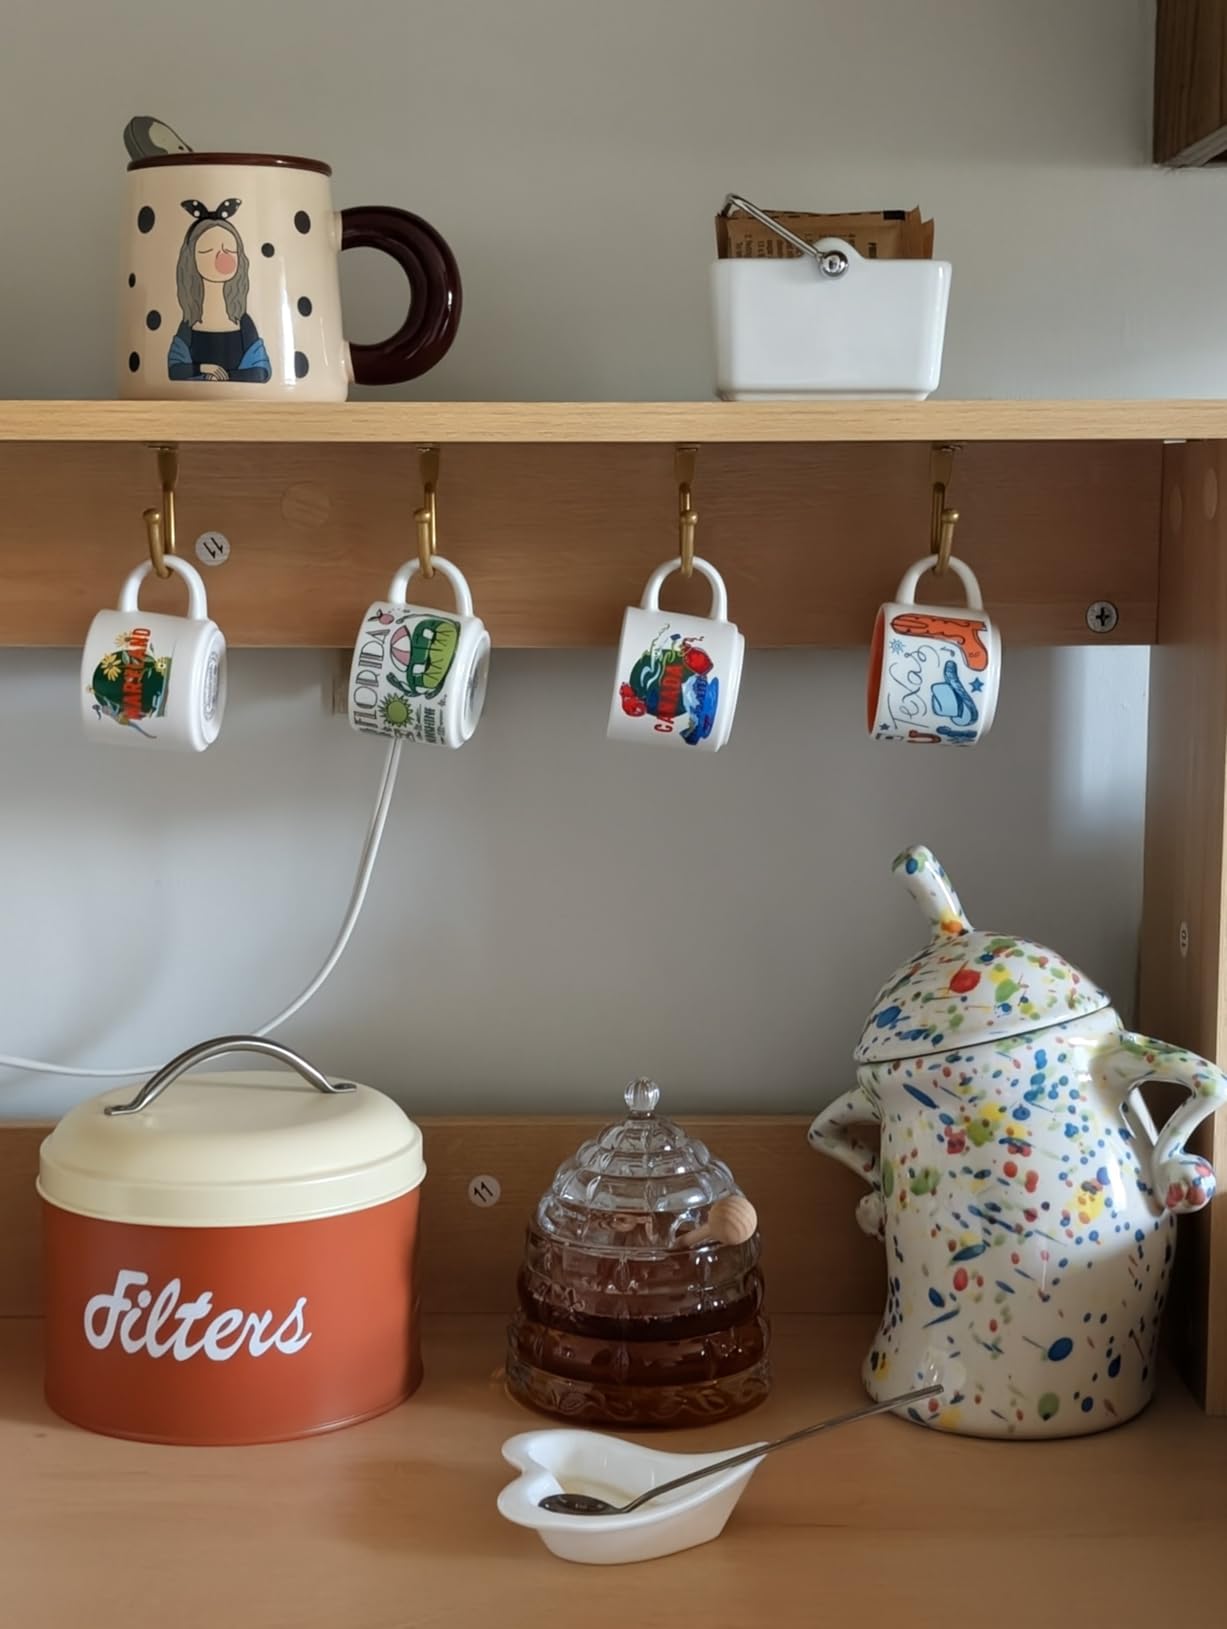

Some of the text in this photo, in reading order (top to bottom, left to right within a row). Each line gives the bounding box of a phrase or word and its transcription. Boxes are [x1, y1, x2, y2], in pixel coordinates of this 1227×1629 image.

[353, 629, 391, 729] FLORIDA
[654, 664, 684, 733] CANADA
[887, 644, 941, 730] Texas
[84, 1269, 312, 1361] Filters
